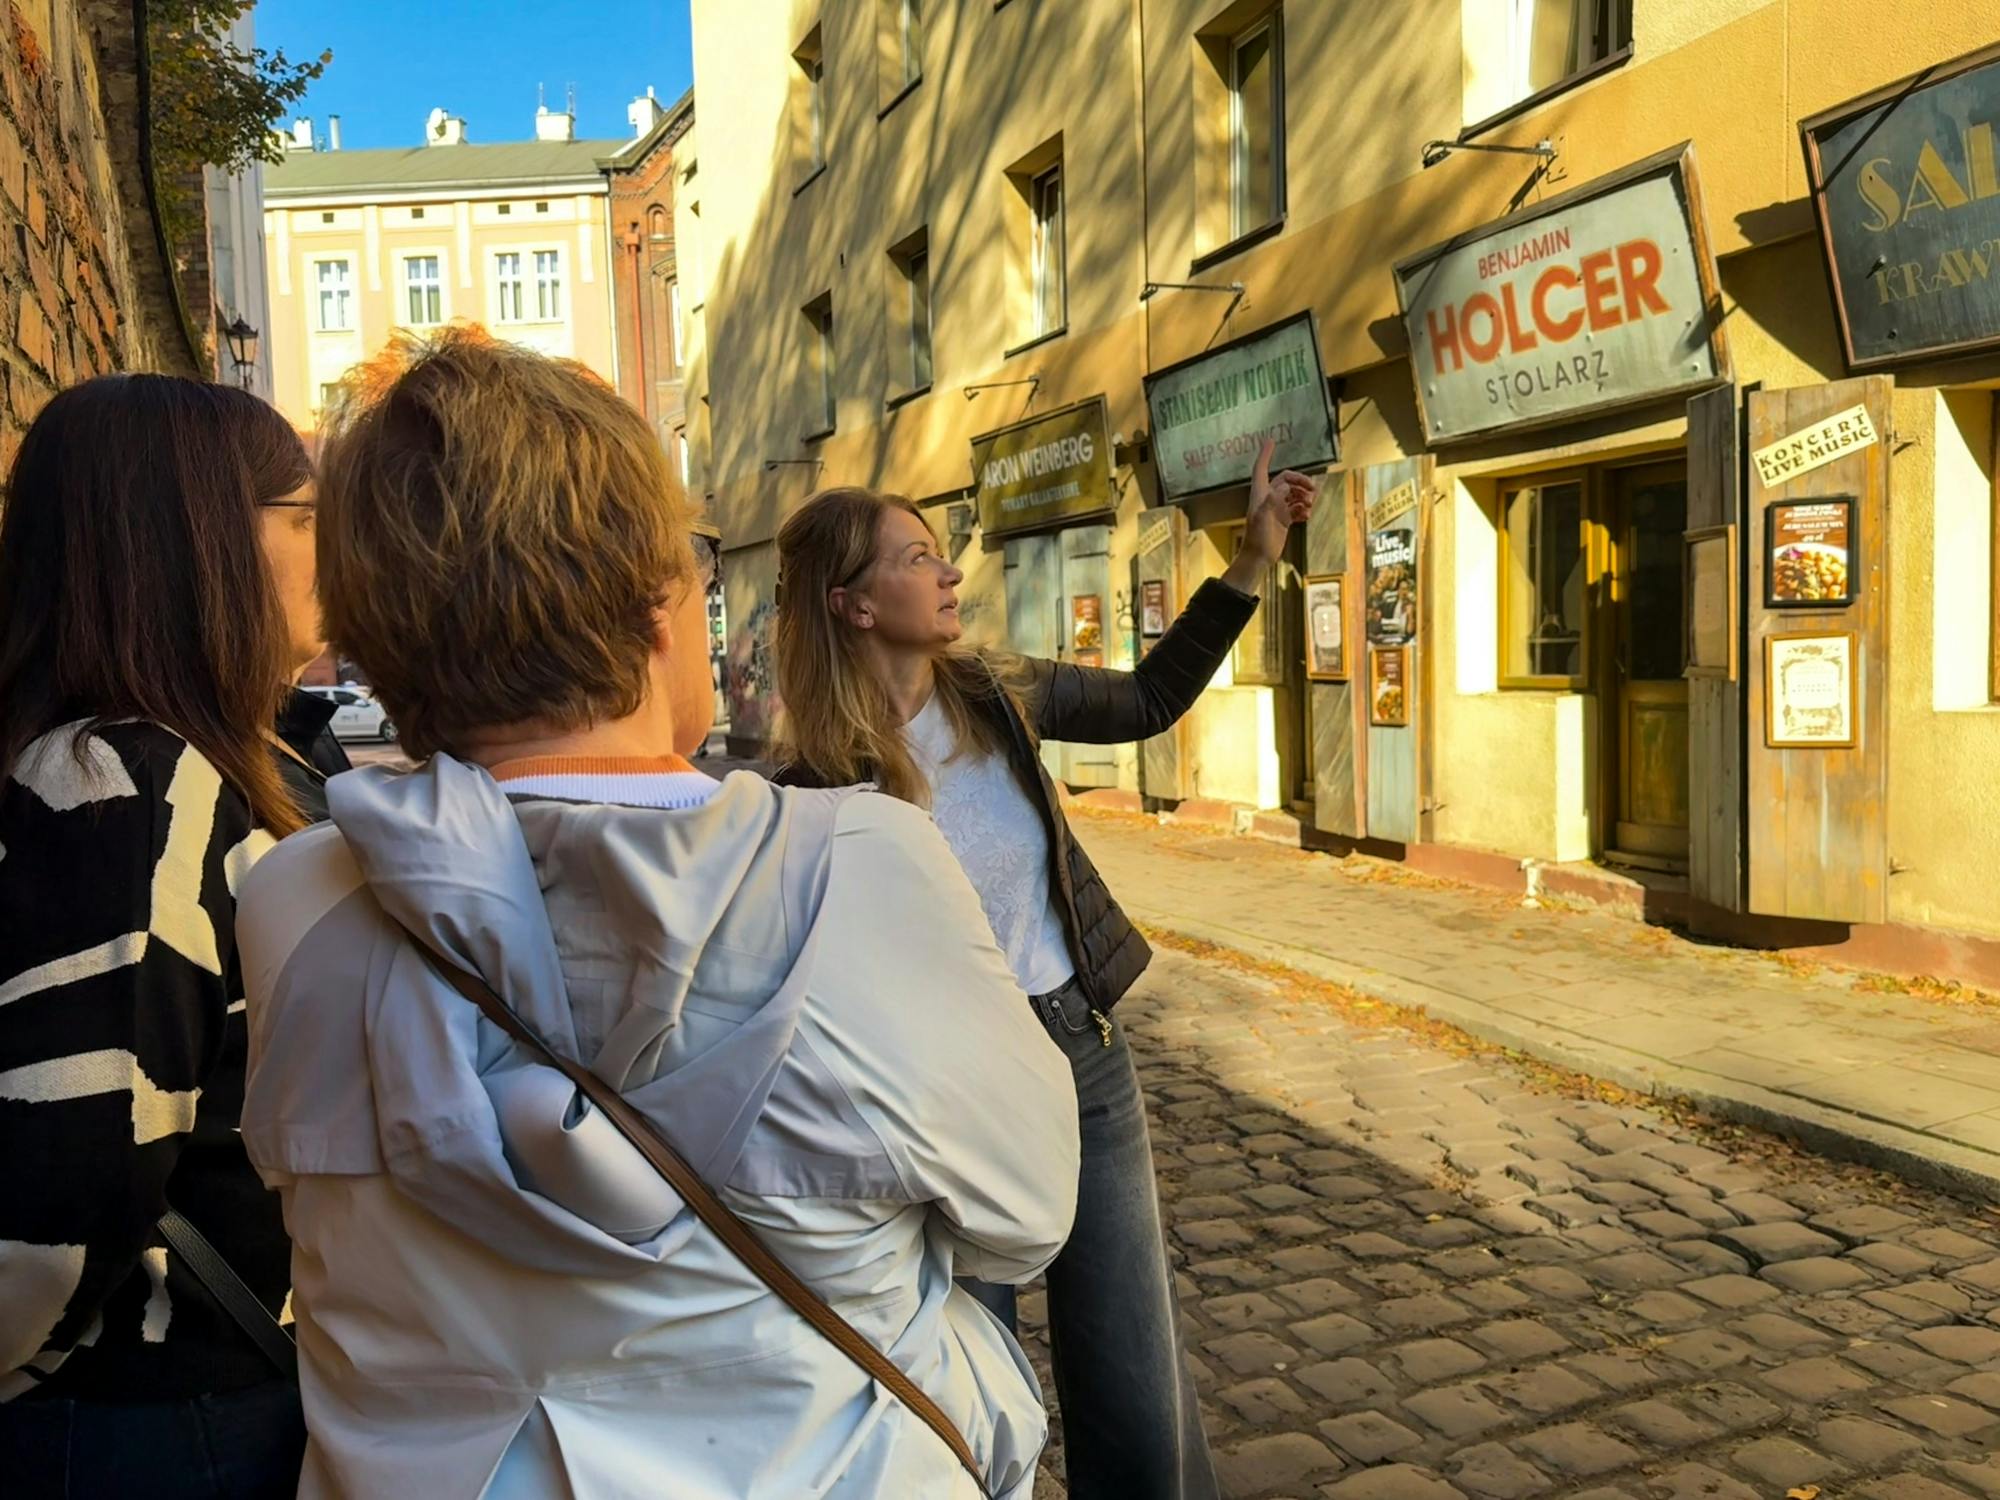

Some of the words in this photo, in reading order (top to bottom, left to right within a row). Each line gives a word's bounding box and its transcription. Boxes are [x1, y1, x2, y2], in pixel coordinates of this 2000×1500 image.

[1478, 226, 1571, 281] BENJAMIN
[1875, 238, 2000, 306] KRAW
[1426, 238, 1673, 376] HOLCER
[1244, 348, 1310, 403] NOWAK
[1486, 350, 1610, 404] STOLARZ
[984, 454, 1020, 489] ARON
[1020, 432, 1093, 478] WEINBERG
[1758, 413, 1865, 469] KONCERT
[1763, 454, 1805, 482] LIVE
[1809, 426, 1871, 462] MUSIC
[1372, 542, 1411, 569] music
